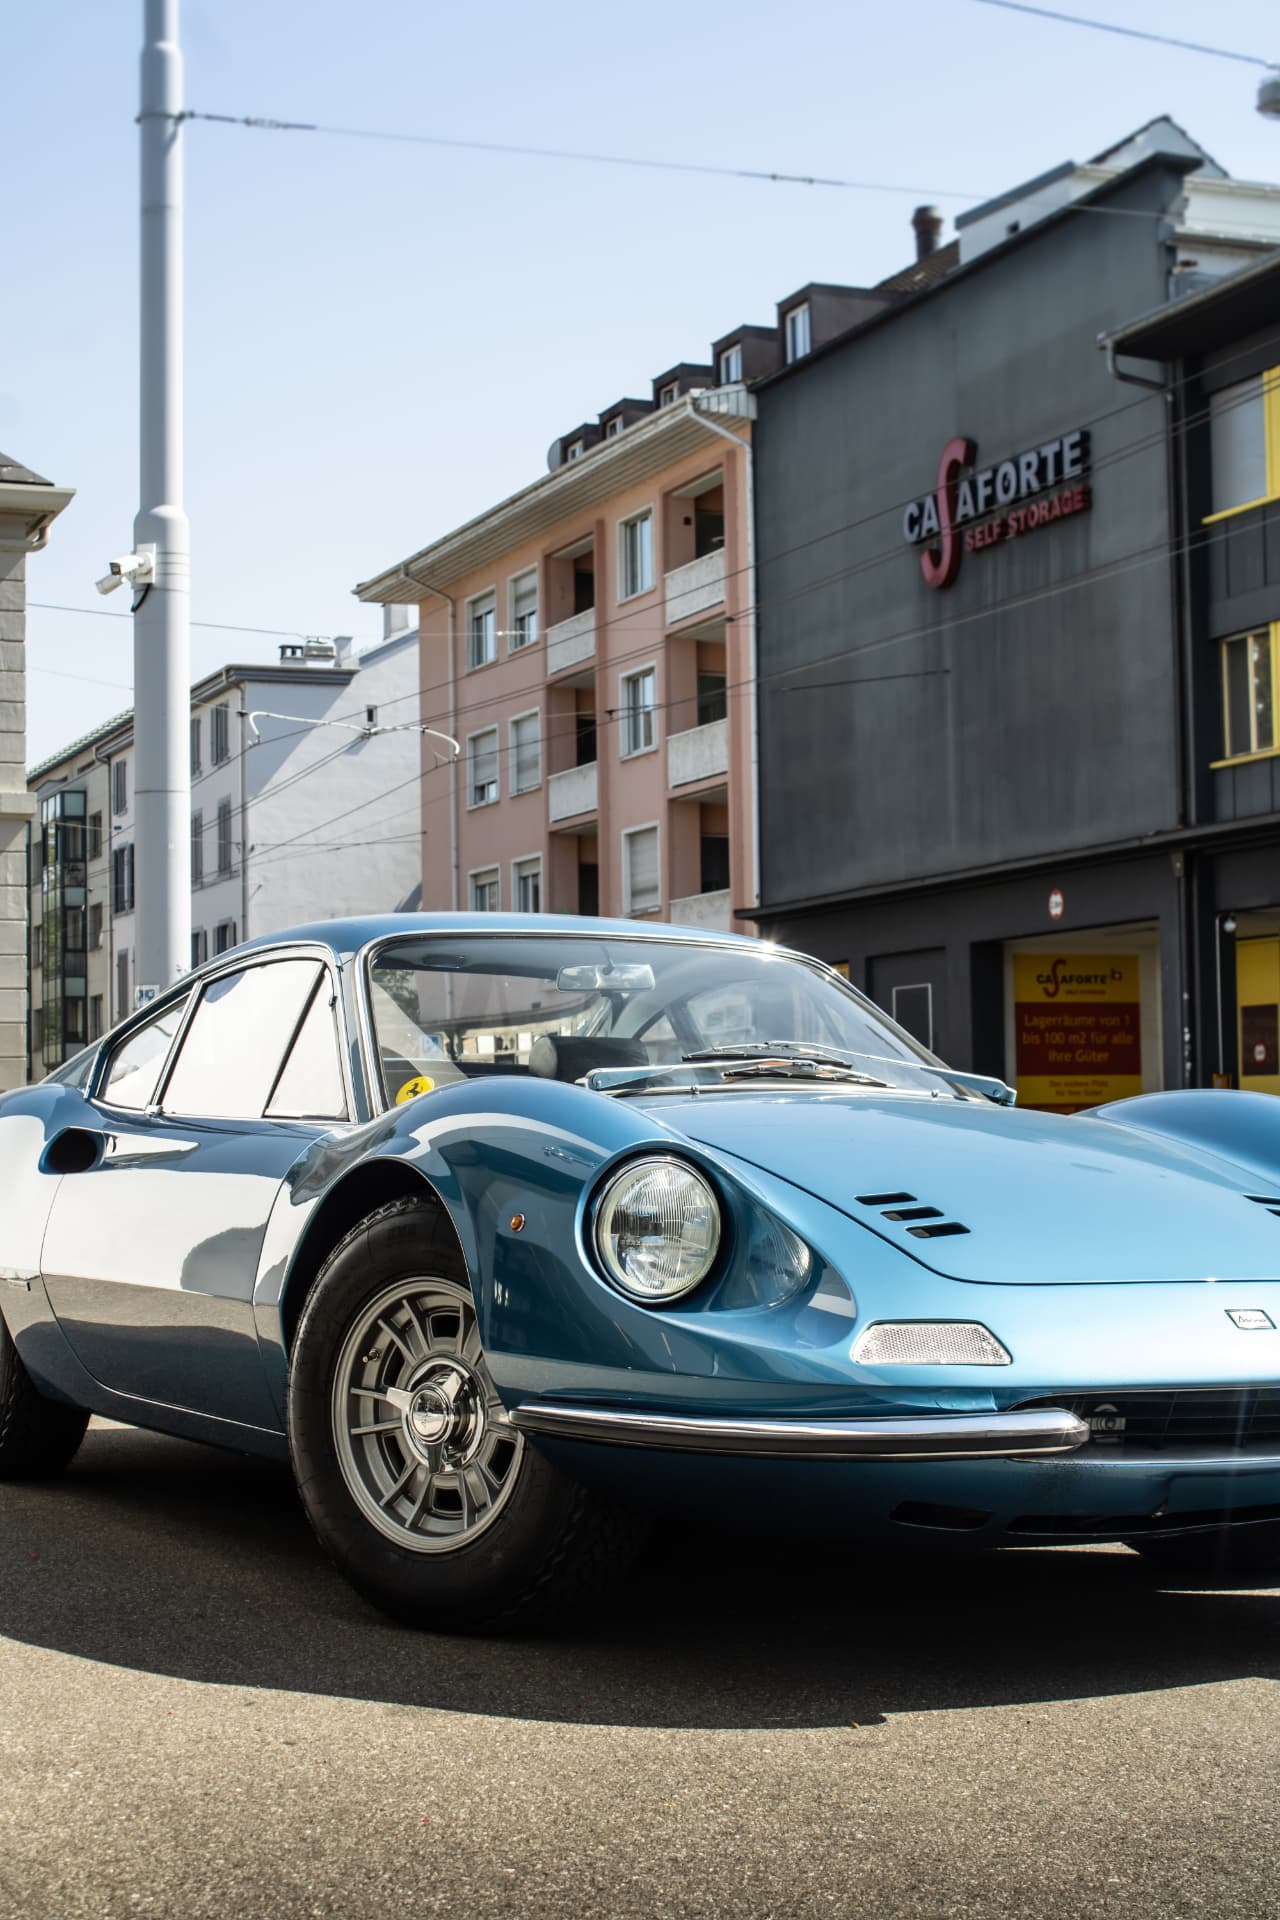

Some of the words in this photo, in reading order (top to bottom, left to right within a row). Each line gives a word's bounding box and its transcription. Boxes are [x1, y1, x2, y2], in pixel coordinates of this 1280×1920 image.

[904, 431, 1086, 587] CASAFORTE
[964, 521, 1002, 551] SELF
[1007, 486, 1087, 537] STORAGE
[1036, 959, 1107, 998] CASAFORTE
[1101, 1016, 1121, 1027] von
[1023, 1031, 1040, 1044] bis
[1045, 1031, 1065, 1044] 100
[1091, 1031, 1107, 1044] für
[1111, 1031, 1134, 1044] alle
[1048, 1050, 1072, 1062] Ihre
[1076, 1049, 1110, 1062] Güter
